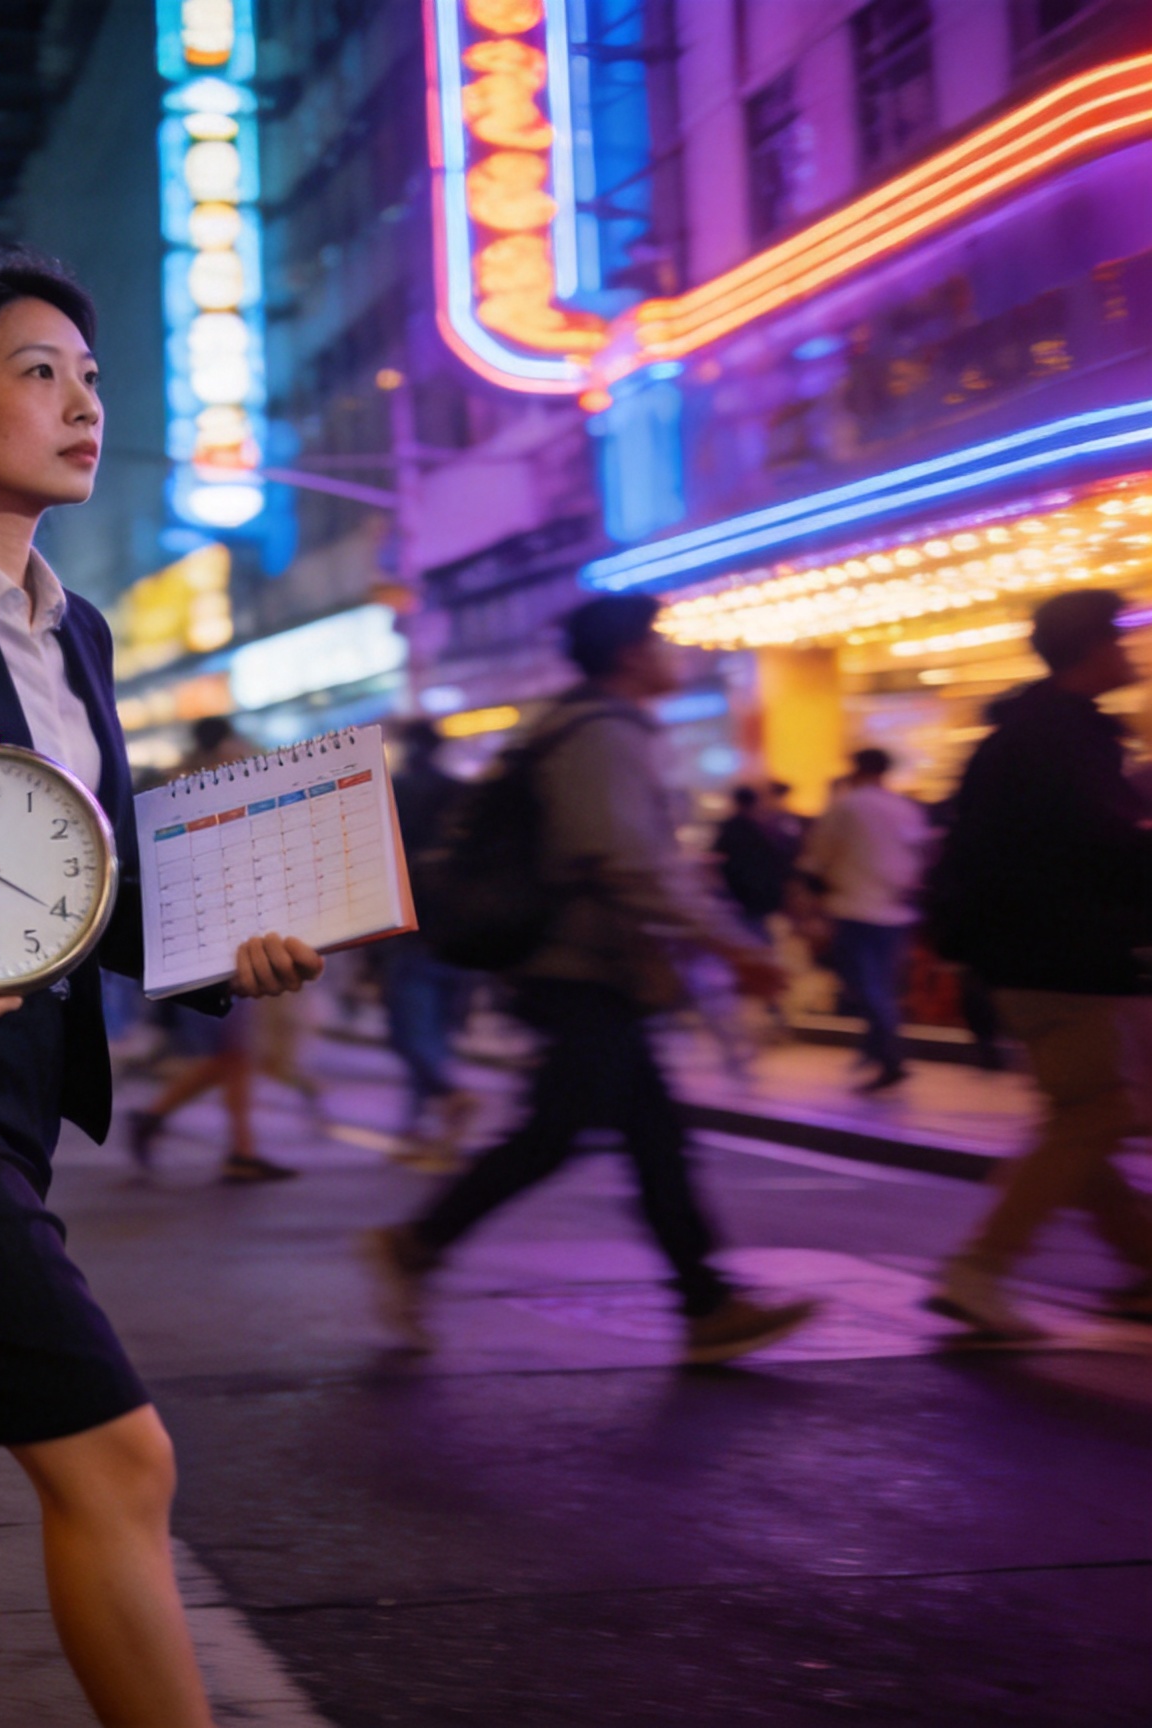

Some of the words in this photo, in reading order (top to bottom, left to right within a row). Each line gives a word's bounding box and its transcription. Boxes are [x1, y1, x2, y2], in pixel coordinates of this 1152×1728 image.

[26, 791, 34, 813] 1
[50, 818, 69, 840] 2
[63, 857, 80, 878] 3
[49, 896, 70, 921] 4
[23, 929, 41, 954] 5
